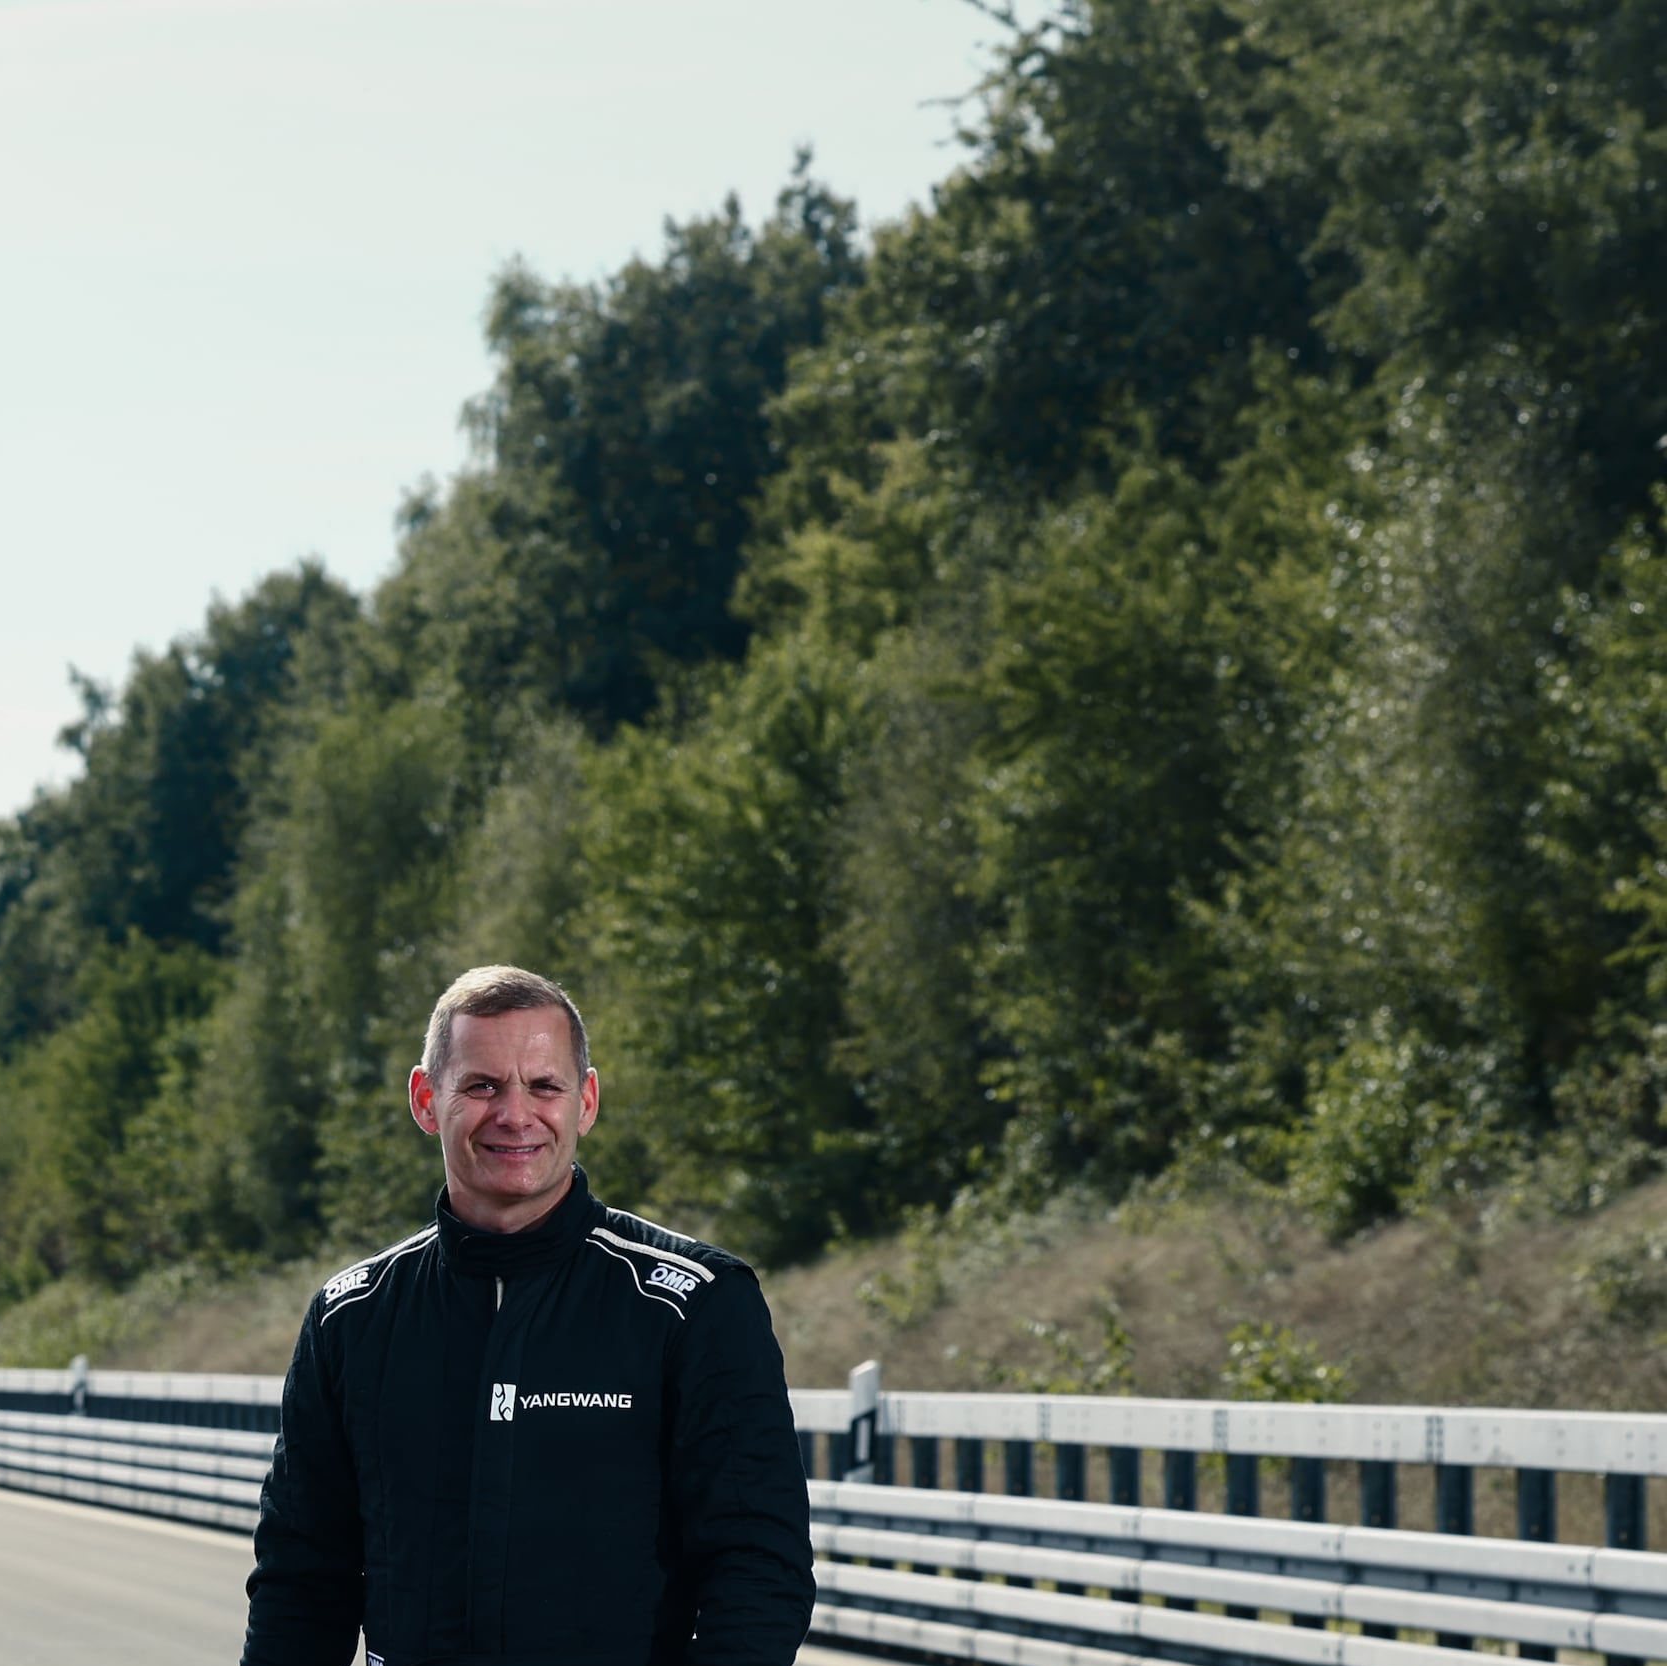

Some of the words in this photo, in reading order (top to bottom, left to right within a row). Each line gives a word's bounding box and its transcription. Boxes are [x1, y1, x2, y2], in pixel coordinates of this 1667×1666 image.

[325, 1271, 369, 1299] OMP
[651, 1266, 697, 1292] OMP
[519, 1393, 633, 1410] YANGWANG
